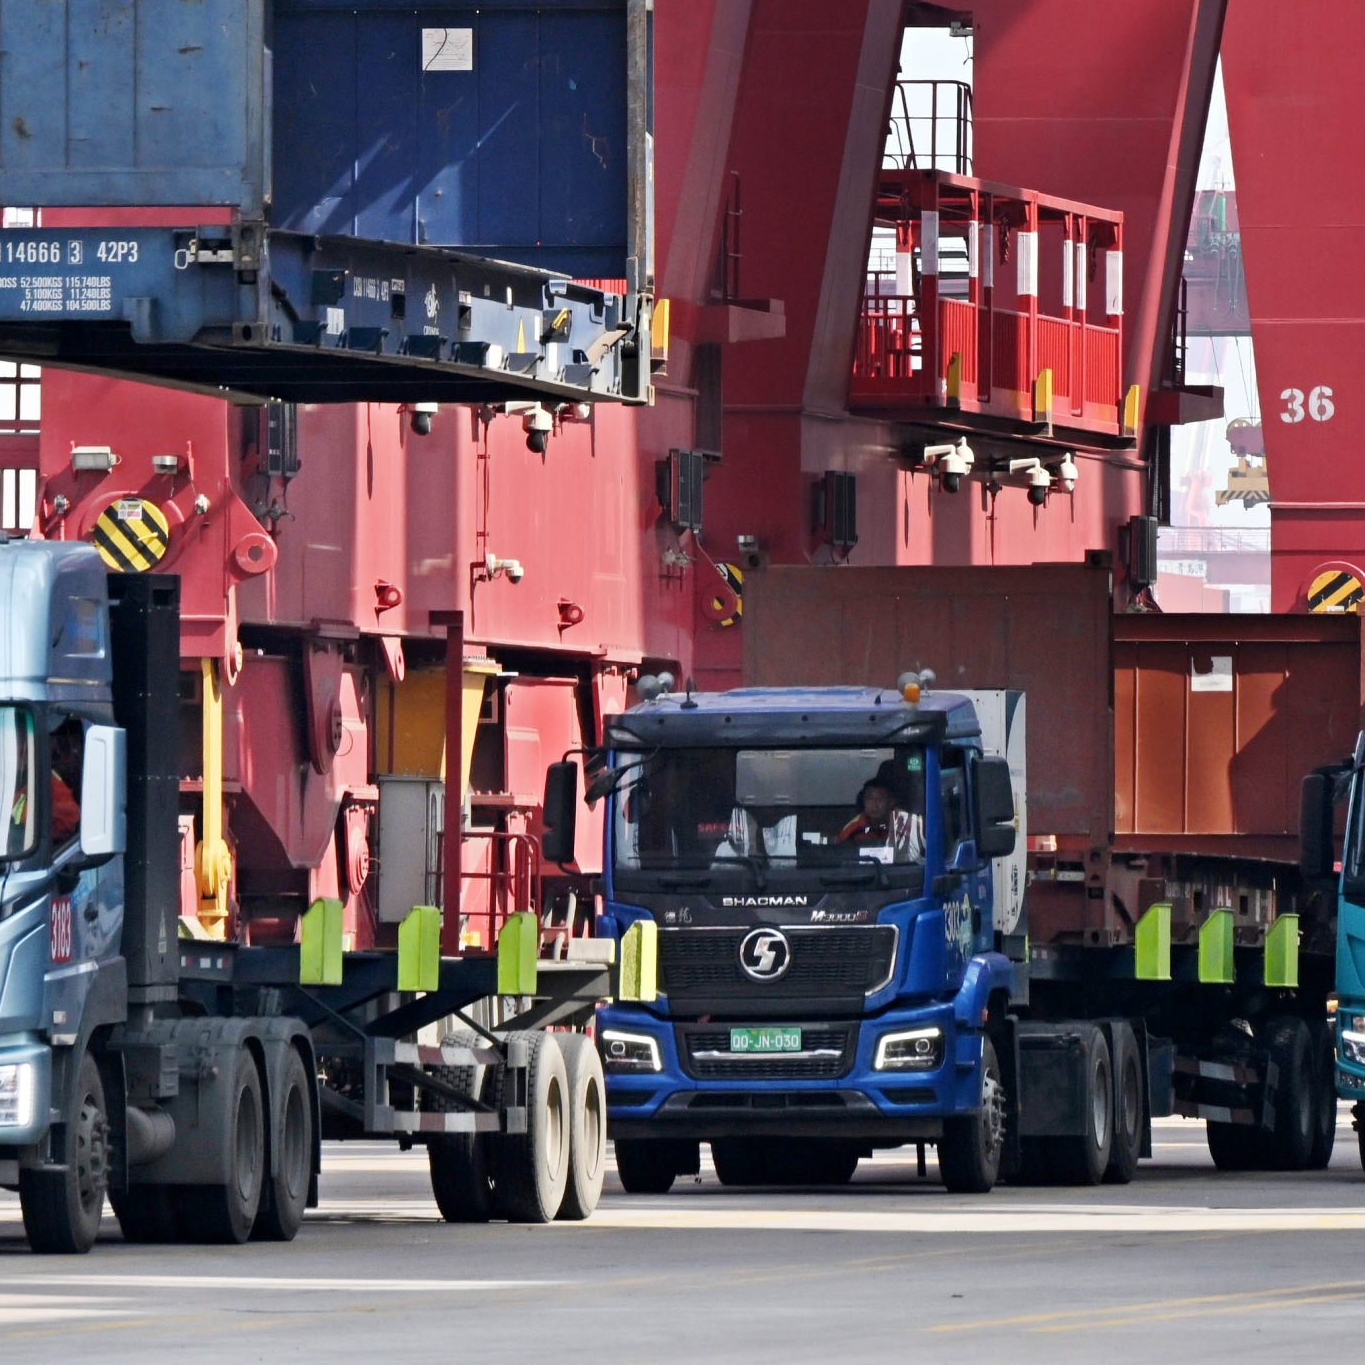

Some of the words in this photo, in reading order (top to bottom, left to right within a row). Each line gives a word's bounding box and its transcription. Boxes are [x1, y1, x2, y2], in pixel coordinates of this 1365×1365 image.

[69, 241, 81, 263] 3
[97, 241, 138, 262] 42P3
[1279, 385, 1335, 424] 36
[722, 896, 807, 907] SHACMAN
[51, 901, 72, 960] 3183
